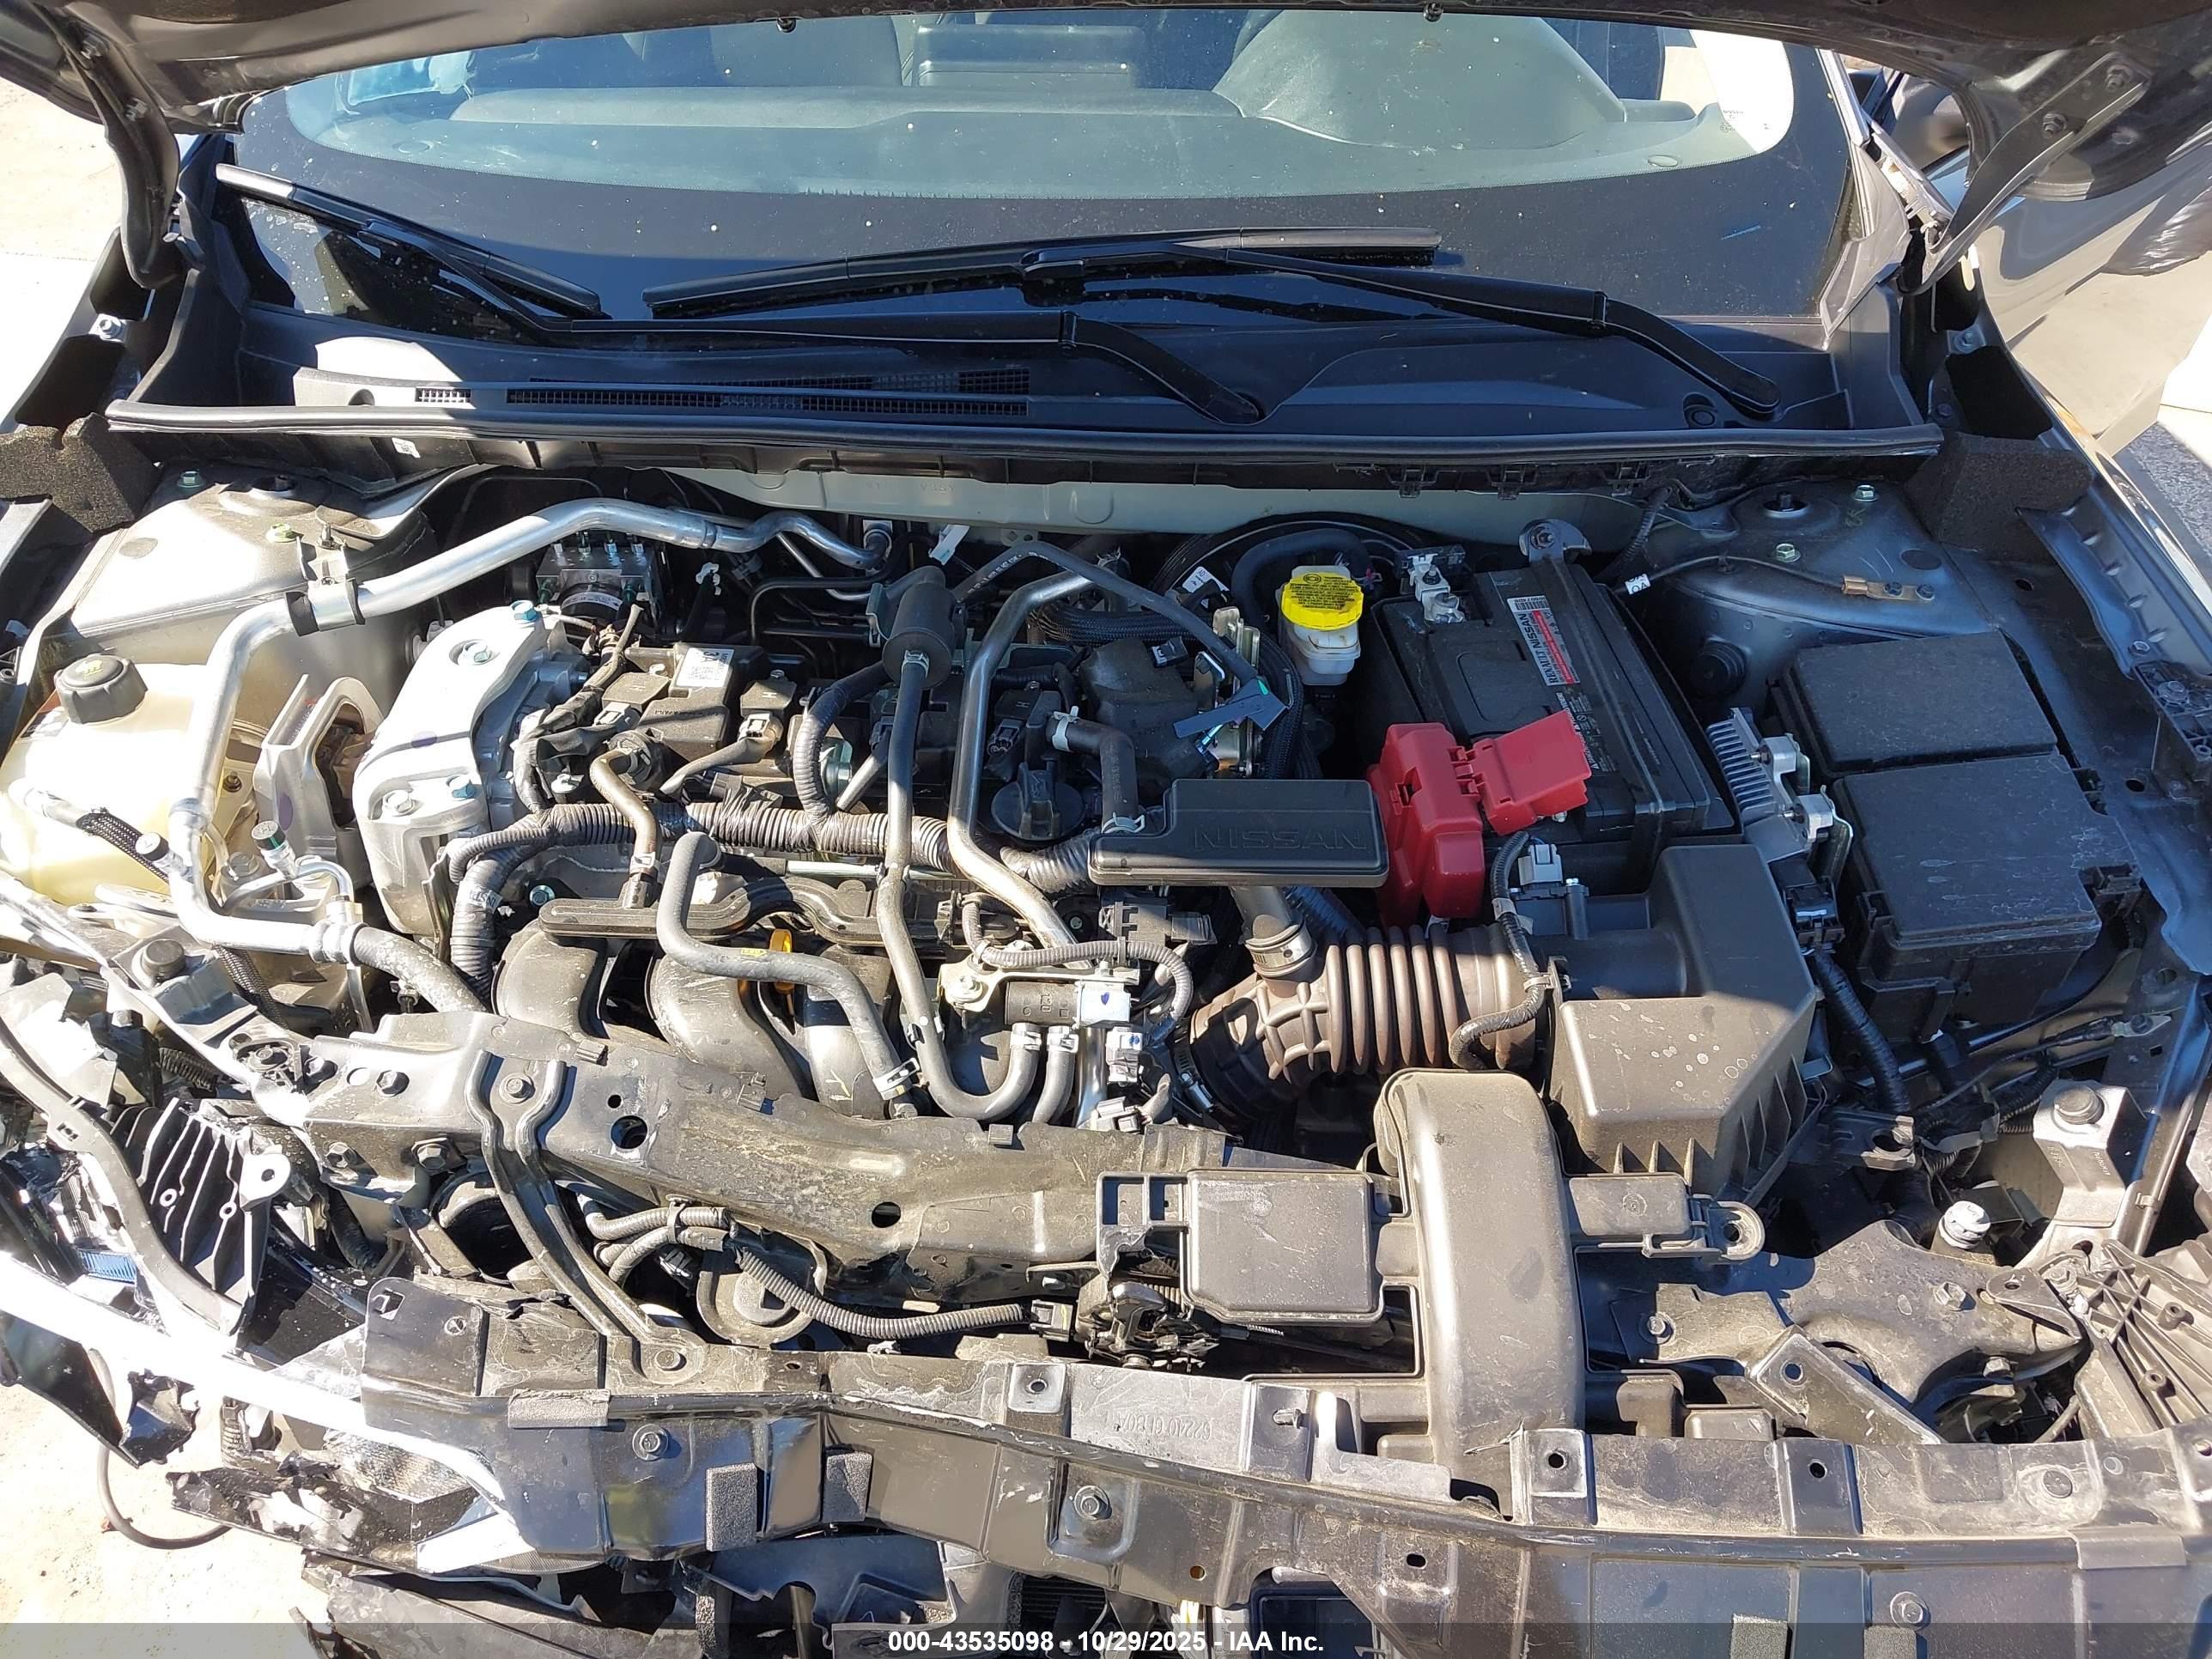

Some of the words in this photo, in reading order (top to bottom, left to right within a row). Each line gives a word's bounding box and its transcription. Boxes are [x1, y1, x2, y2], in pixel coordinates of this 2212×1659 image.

[1517, 612, 1545, 649] NISSAN
[1537, 649, 1559, 684] RENAULT
[1194, 825, 1367, 851] NISSAN
